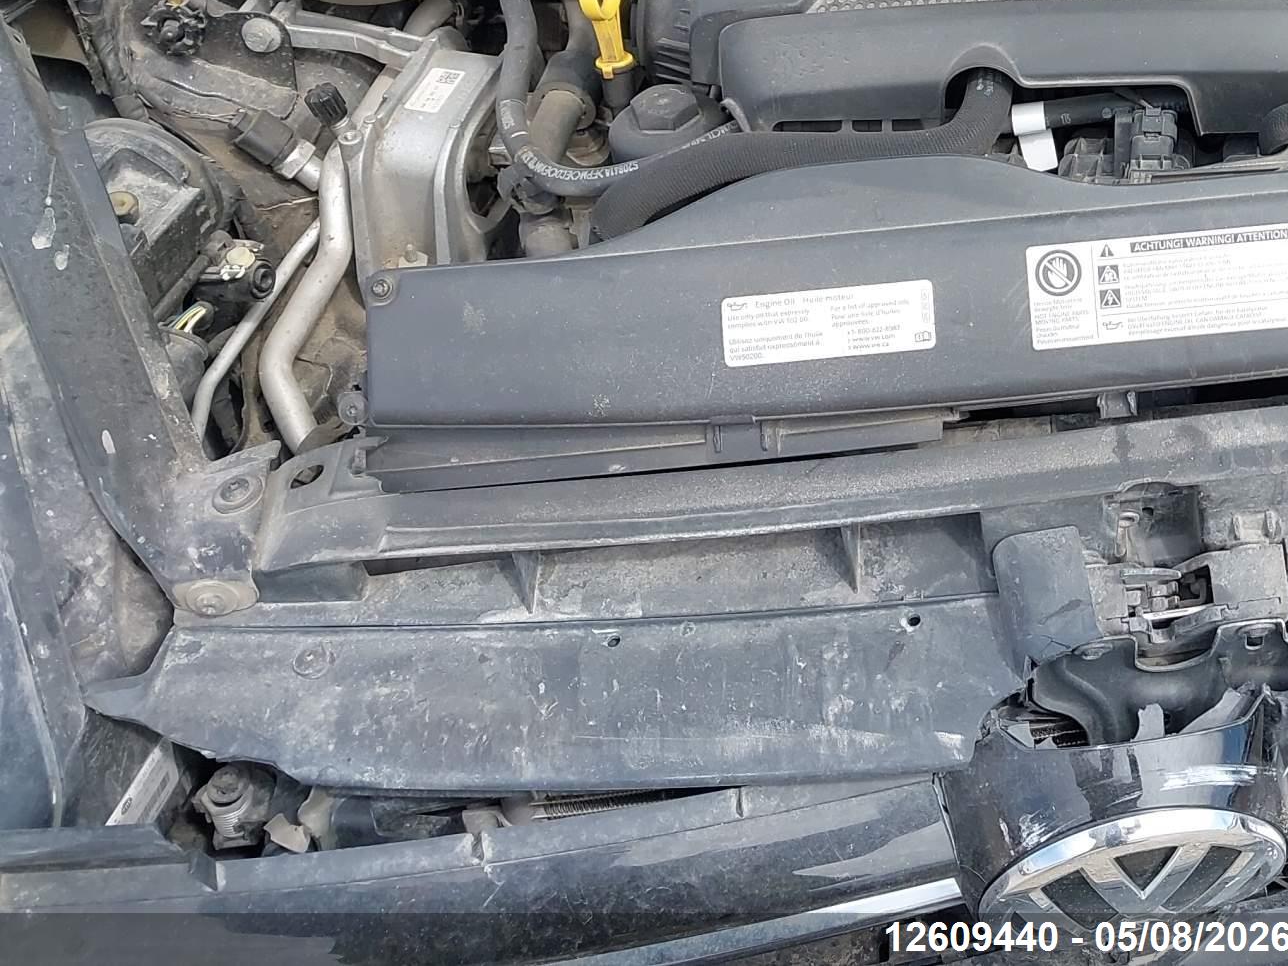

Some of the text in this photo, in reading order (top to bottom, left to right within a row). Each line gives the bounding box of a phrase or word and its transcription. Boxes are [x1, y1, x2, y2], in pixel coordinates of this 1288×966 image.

[1132, 240, 1183, 252] ACHTUNG!
[1185, 235, 1234, 247] WARNING!
[755, 299, 782, 309] Engine
